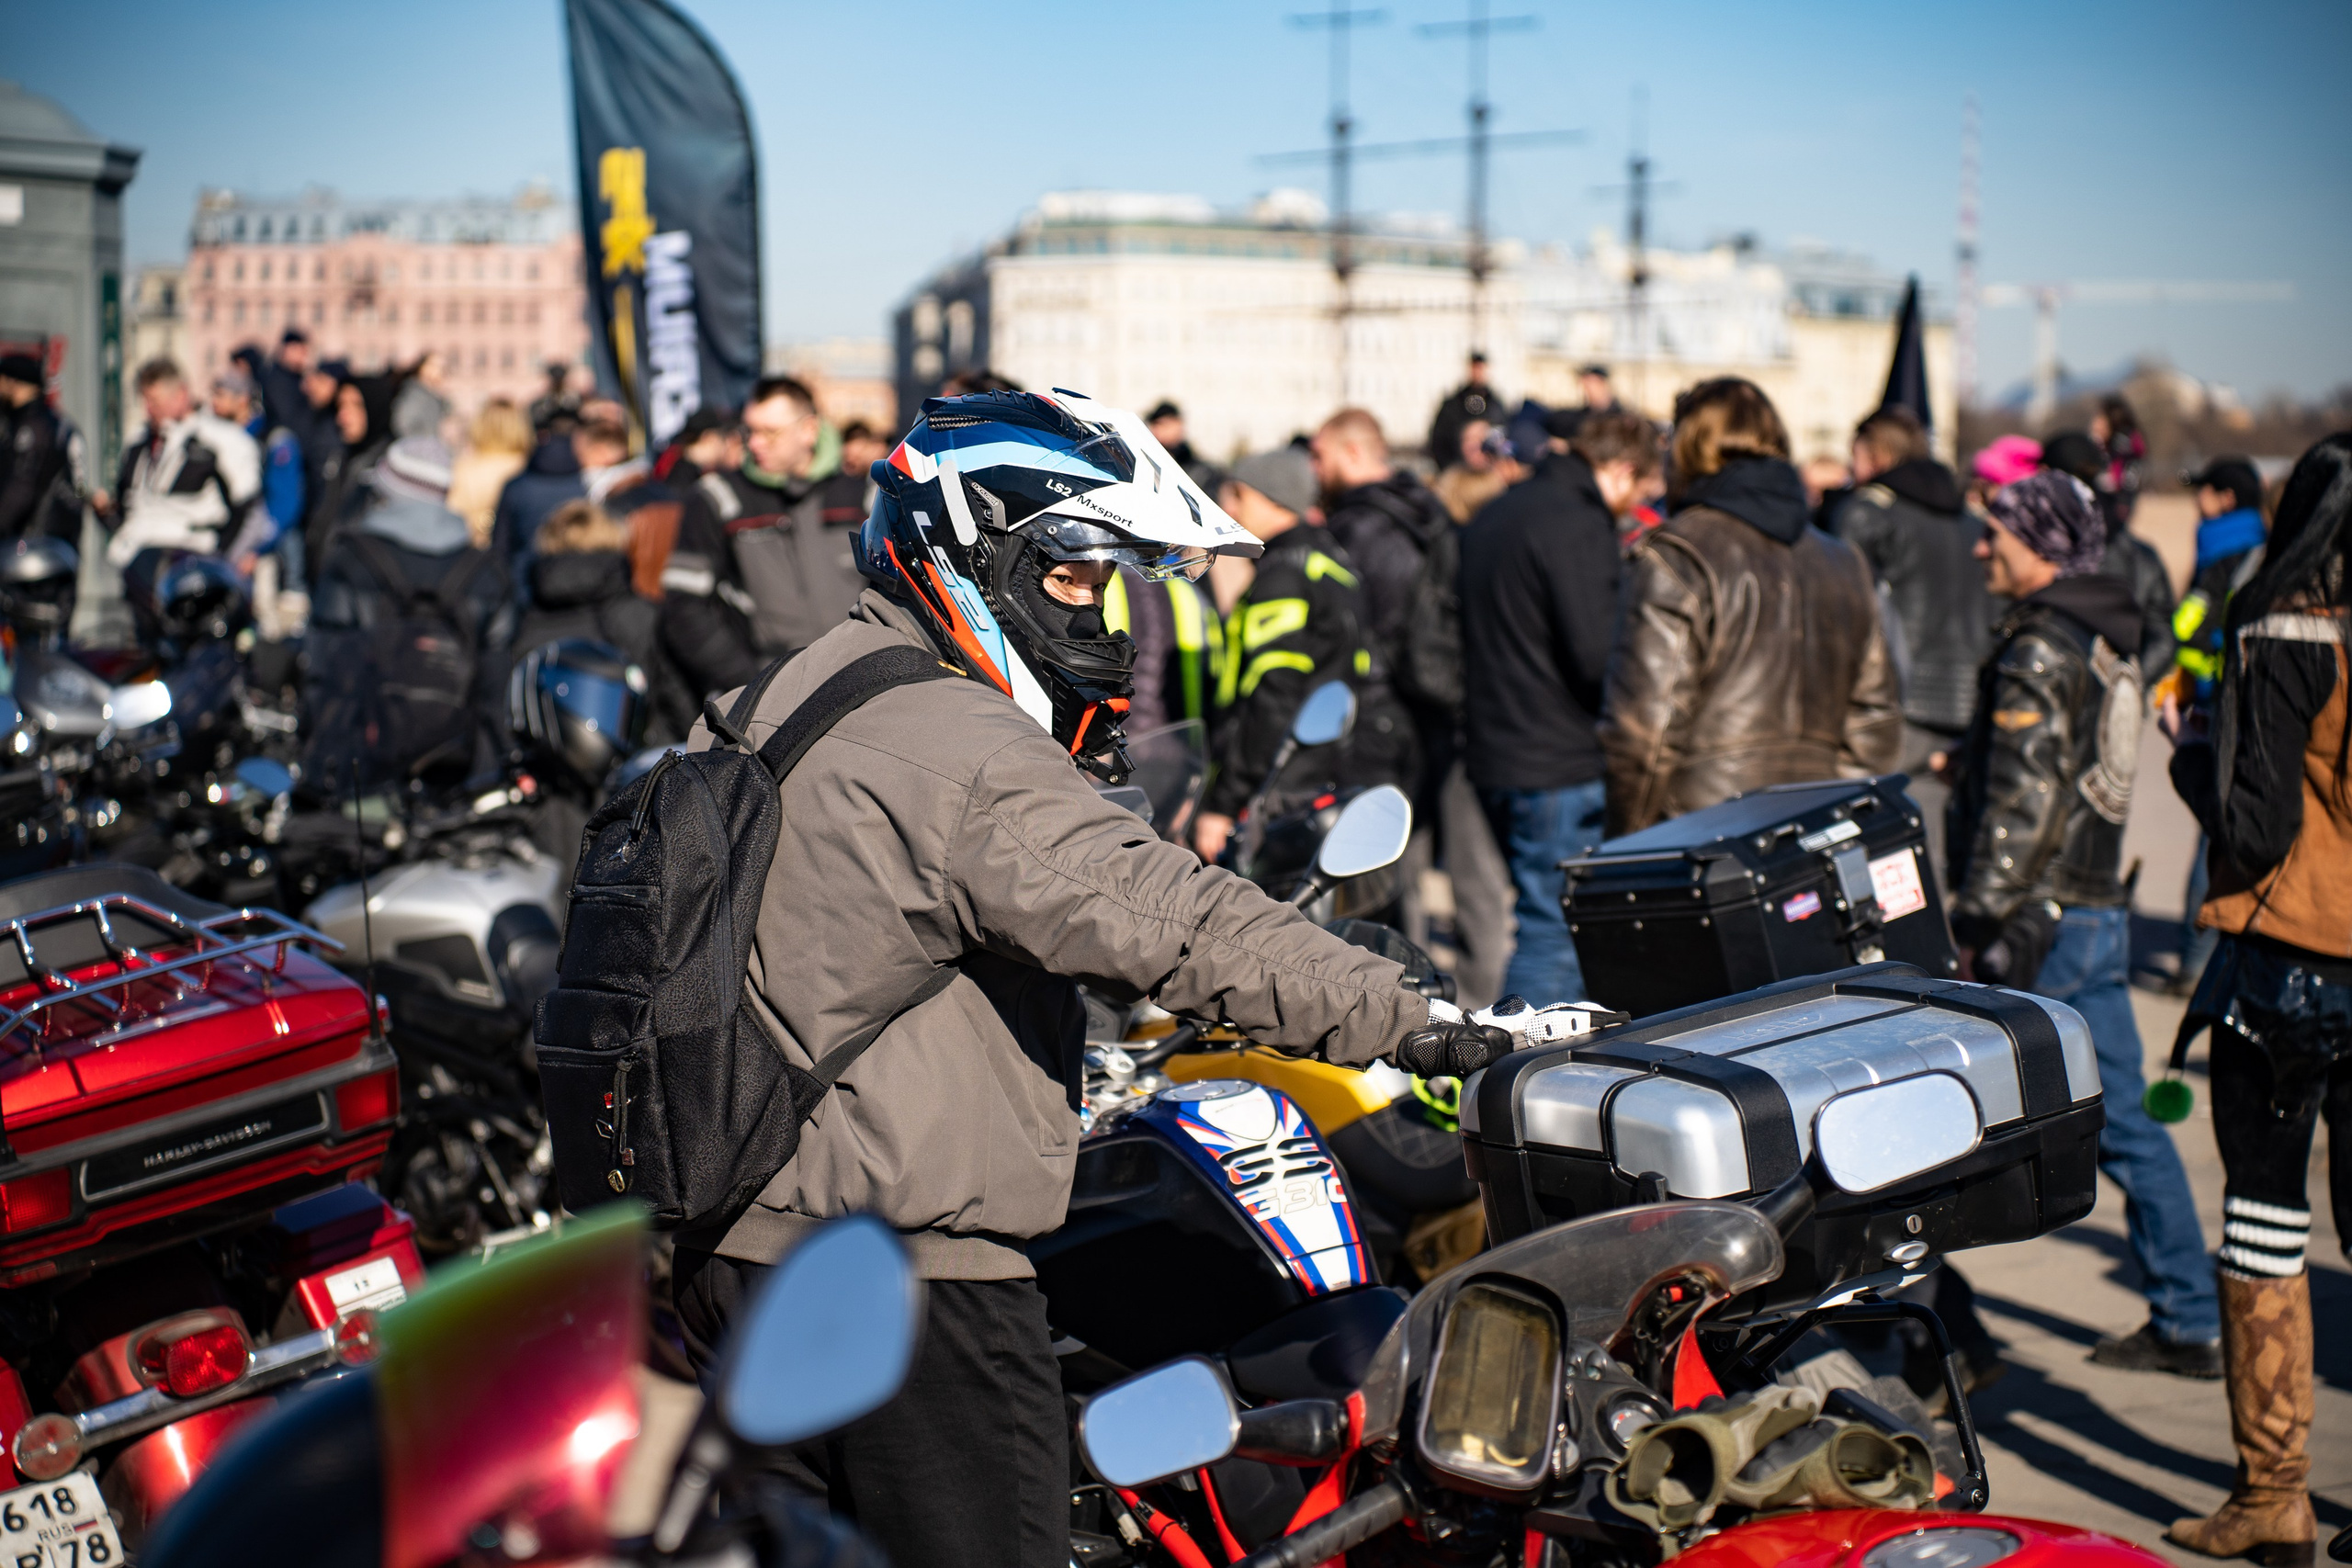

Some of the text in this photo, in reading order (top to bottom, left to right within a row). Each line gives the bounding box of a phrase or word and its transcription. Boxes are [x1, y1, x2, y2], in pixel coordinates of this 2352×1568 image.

[1046, 478, 1135, 528] LS2 Mxsport
[912, 511, 989, 631] LS2
[0, 1486, 76, 1534] 618
[38, 1522, 74, 1543] RUS
[59, 1532, 111, 1568] 78
